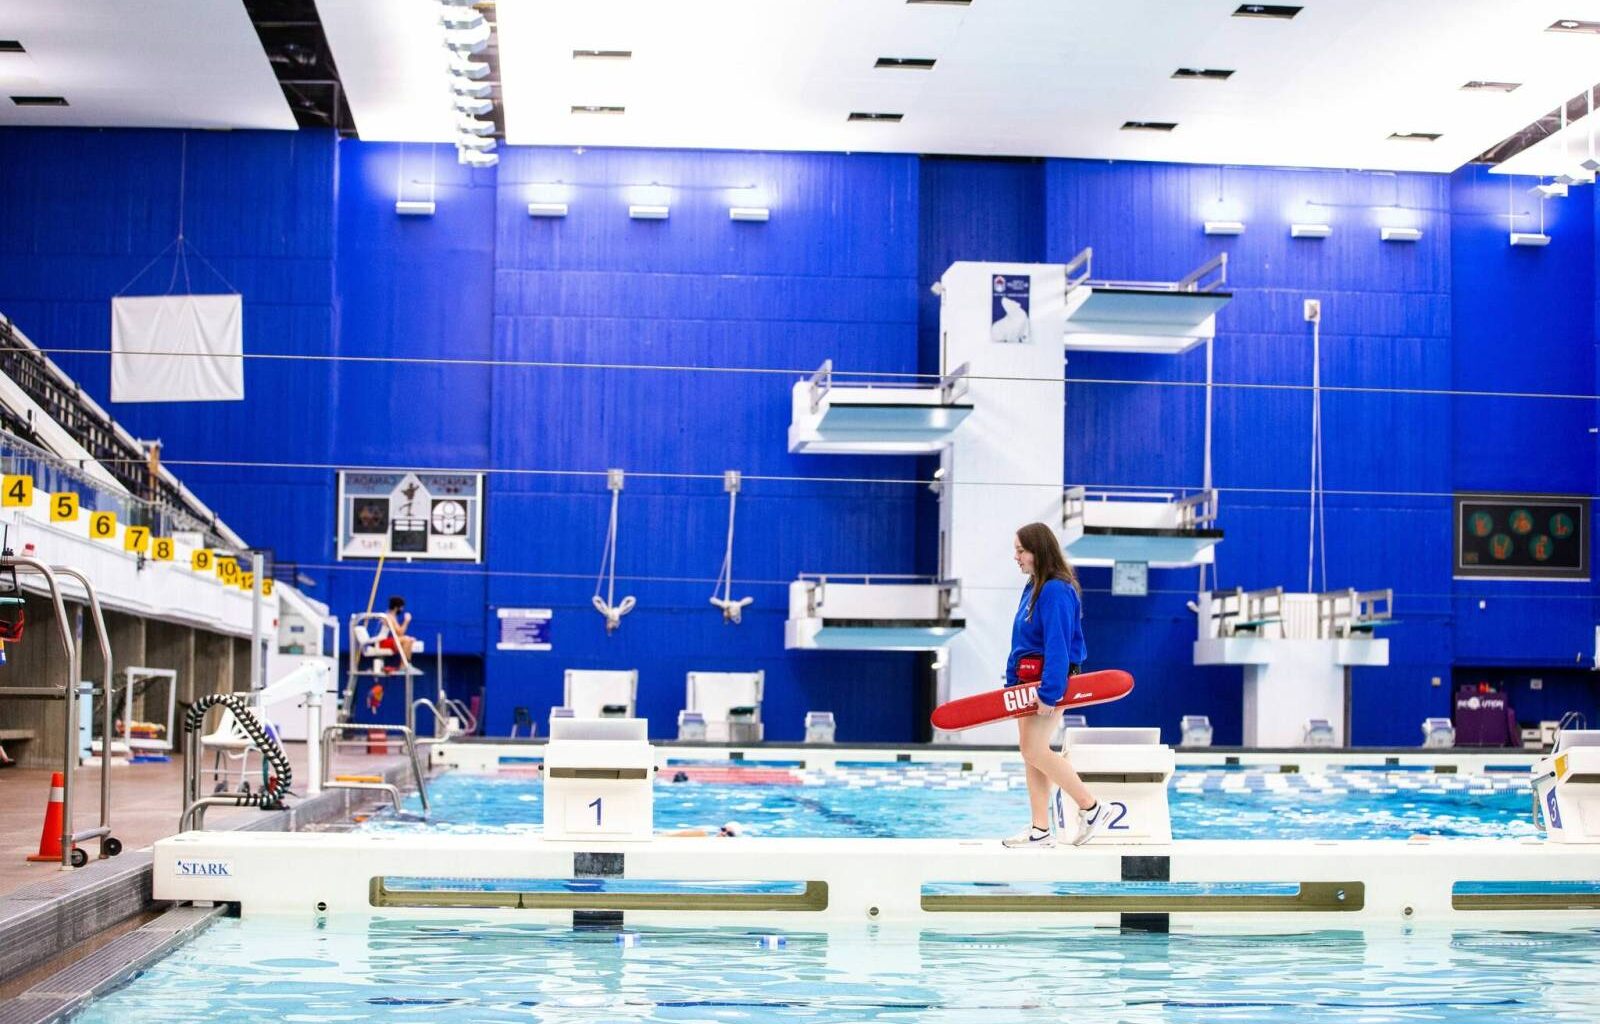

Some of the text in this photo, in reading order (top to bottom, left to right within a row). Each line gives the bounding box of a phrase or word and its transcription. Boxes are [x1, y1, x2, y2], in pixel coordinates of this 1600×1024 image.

[8, 479, 26, 503] 4
[57, 496, 72, 517] 5
[96, 515, 110, 535] 6
[131, 530, 143, 547] 7
[157, 541, 169, 559] 8
[196, 552, 208, 568] 9
[218, 561, 236, 576] 10
[1003, 686, 1039, 712] GUA
[588, 797, 602, 826] 1
[1107, 801, 1130, 830] 2
[1550, 796, 1558, 822] 3
[181, 862, 228, 875] STARK
